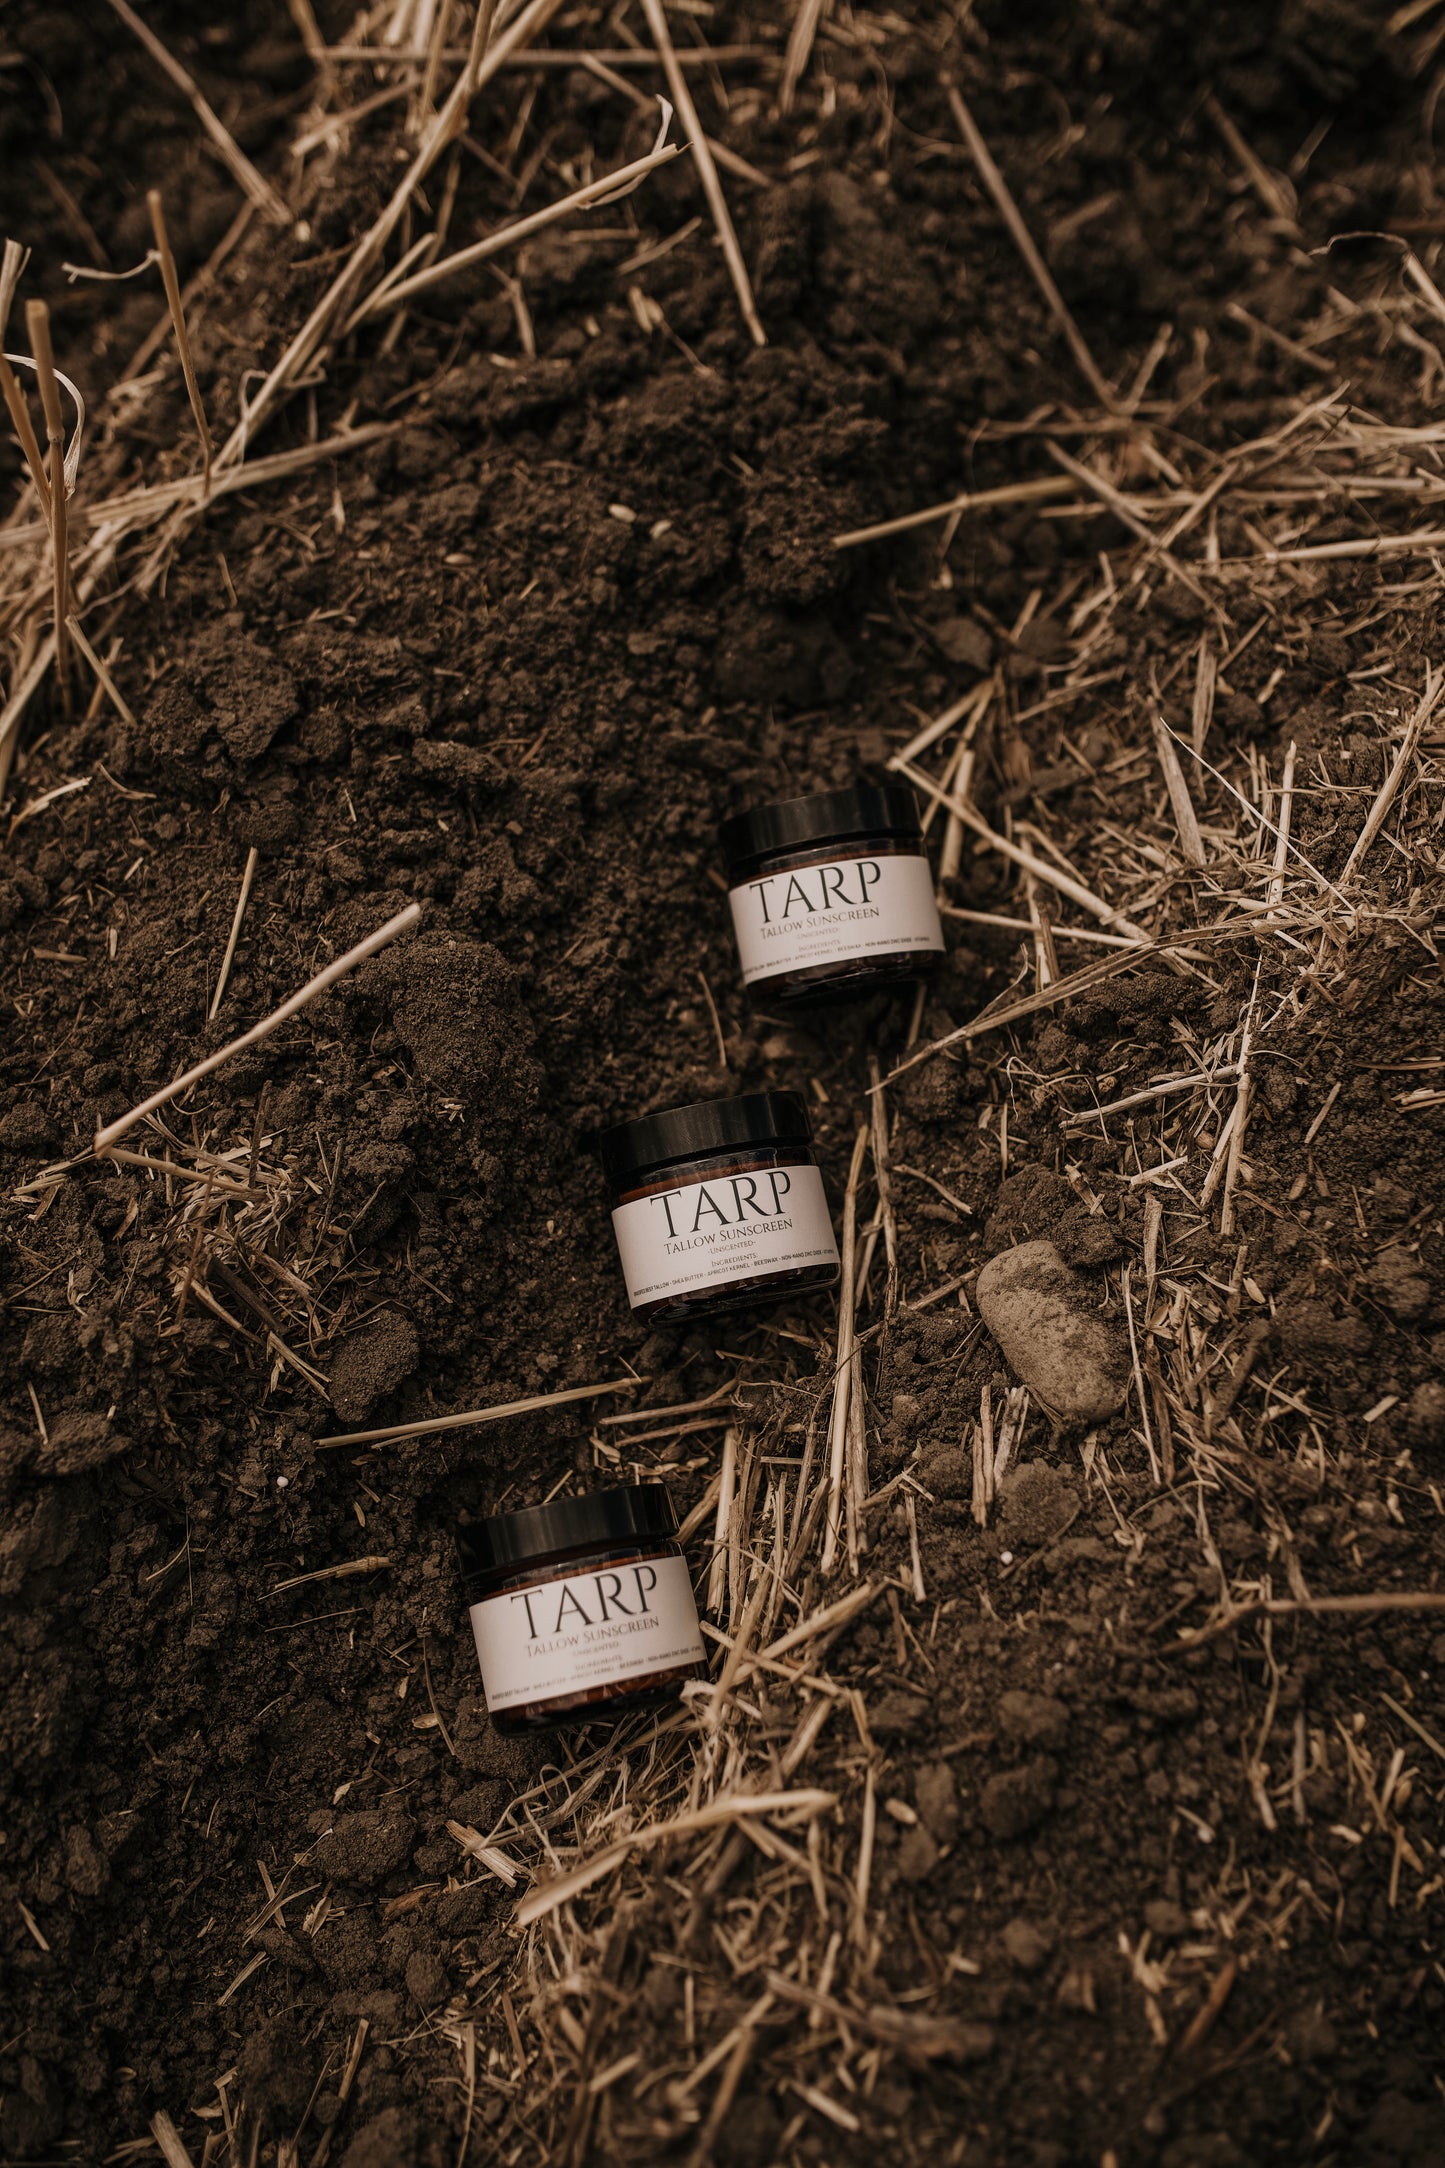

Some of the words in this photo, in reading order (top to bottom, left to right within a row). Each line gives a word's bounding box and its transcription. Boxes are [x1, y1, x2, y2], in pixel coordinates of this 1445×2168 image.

[749, 861, 882, 923] TARP
[760, 920, 803, 940] TALLOW
[806, 907, 880, 928] SUNSCREEN
[650, 1170, 791, 1239] TARP
[664, 1232, 717, 1256] TALLOW
[719, 1218, 793, 1242] SUNSCREEN
[685, 1272, 704, 1282] BUTTER
[754, 1256, 779, 1267] BEESWAX
[510, 1565, 657, 1640] TARP
[526, 1632, 579, 1658] TALLOW
[583, 1616, 660, 1643] SUNSCREEN
